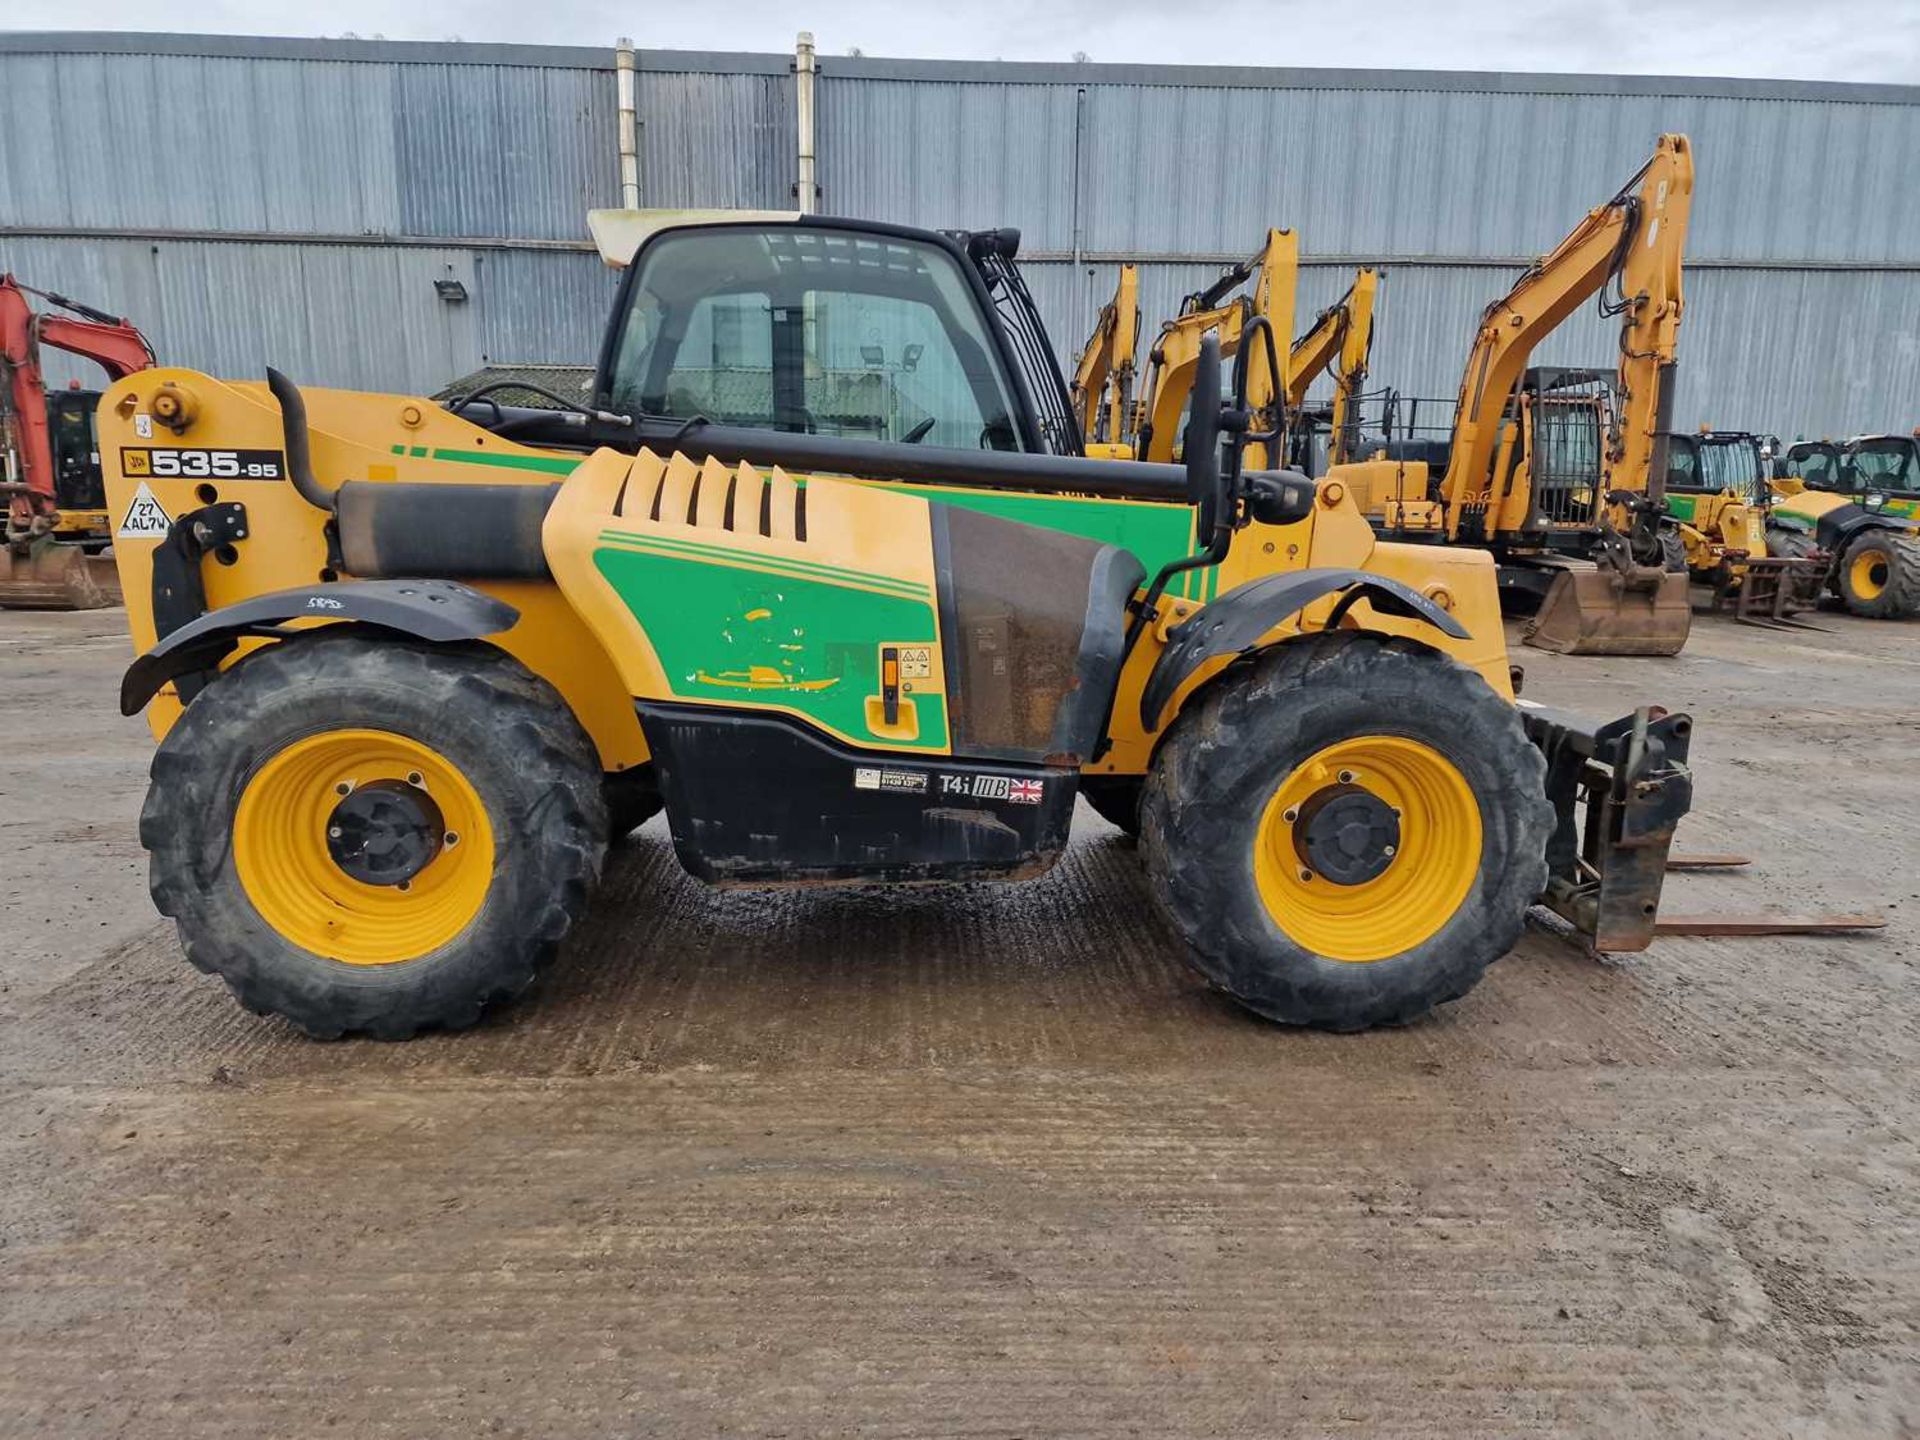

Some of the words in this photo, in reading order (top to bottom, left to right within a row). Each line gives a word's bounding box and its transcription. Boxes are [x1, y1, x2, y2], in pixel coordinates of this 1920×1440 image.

[152, 451, 278, 477] 535-95
[138, 503, 154, 516] 27
[132, 517, 165, 531] AL7W
[939, 775, 970, 795] T4i
